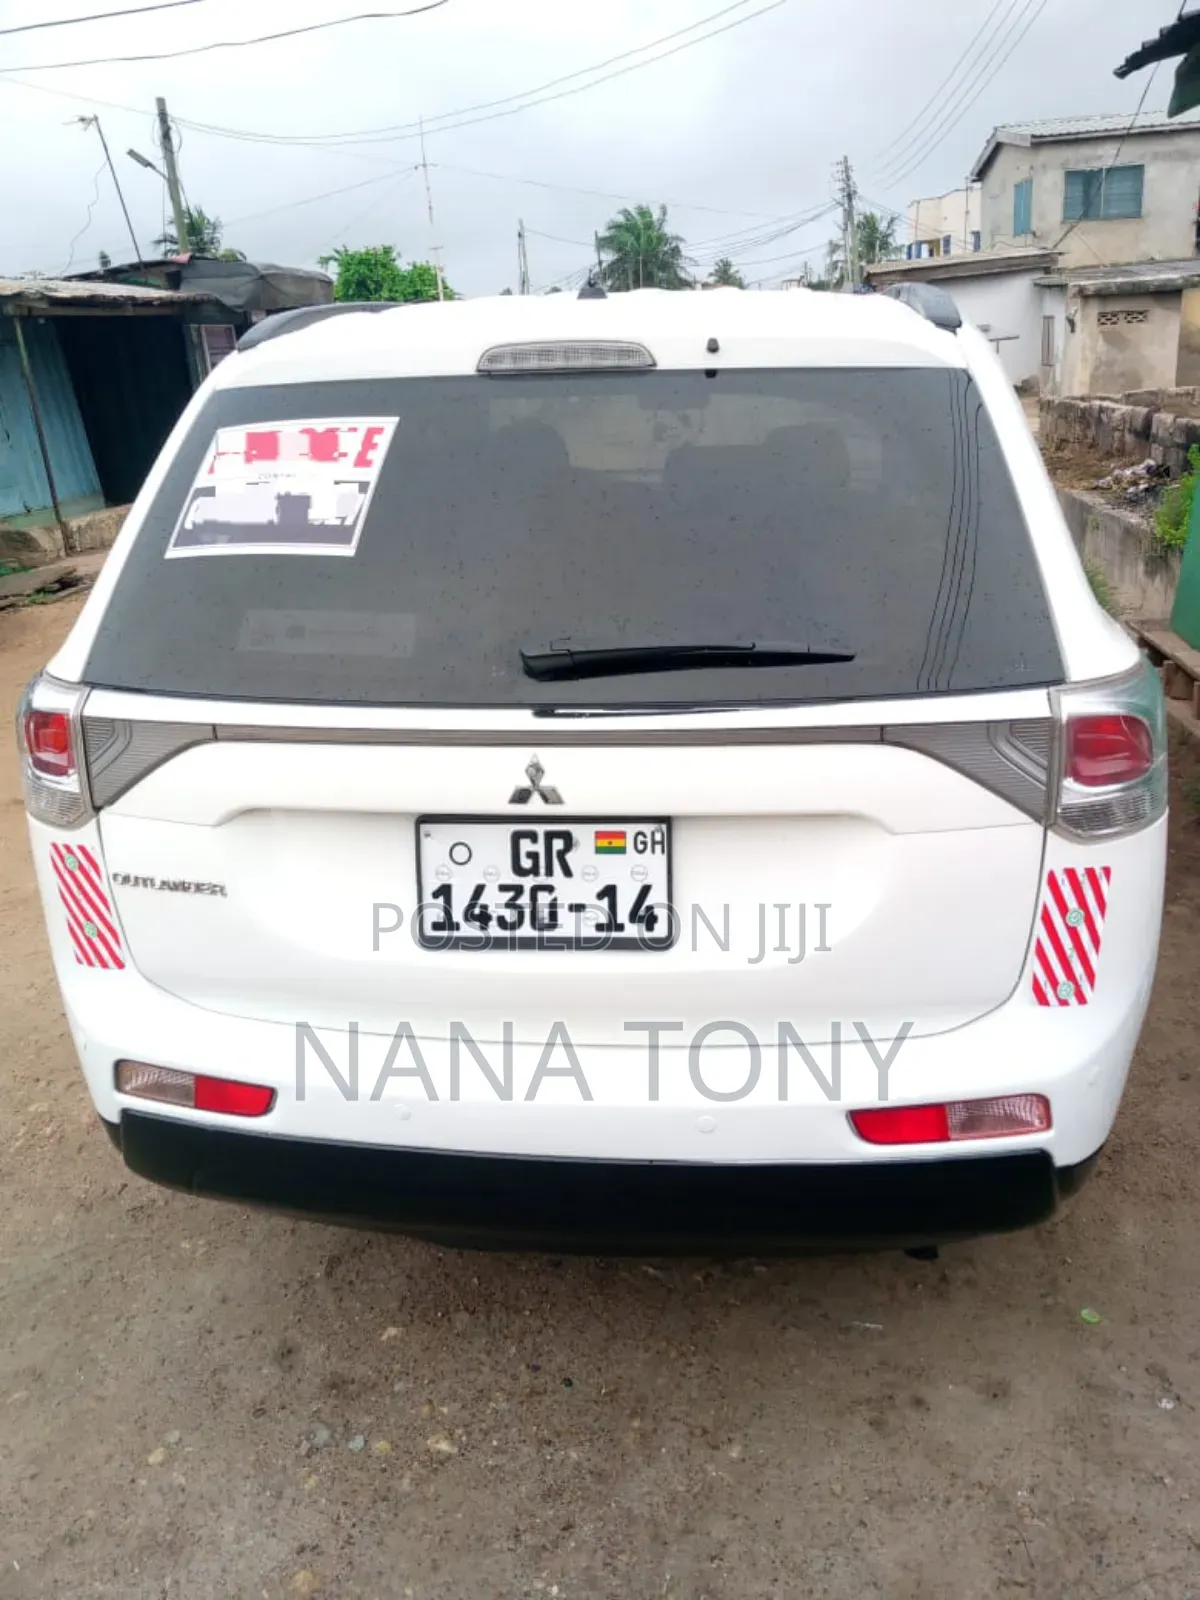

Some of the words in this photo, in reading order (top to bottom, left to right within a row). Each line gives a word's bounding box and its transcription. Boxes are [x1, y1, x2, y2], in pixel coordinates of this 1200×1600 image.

[510, 829, 574, 878] GR
[633, 830, 666, 855] GH
[431, 883, 658, 932] 1430-14
